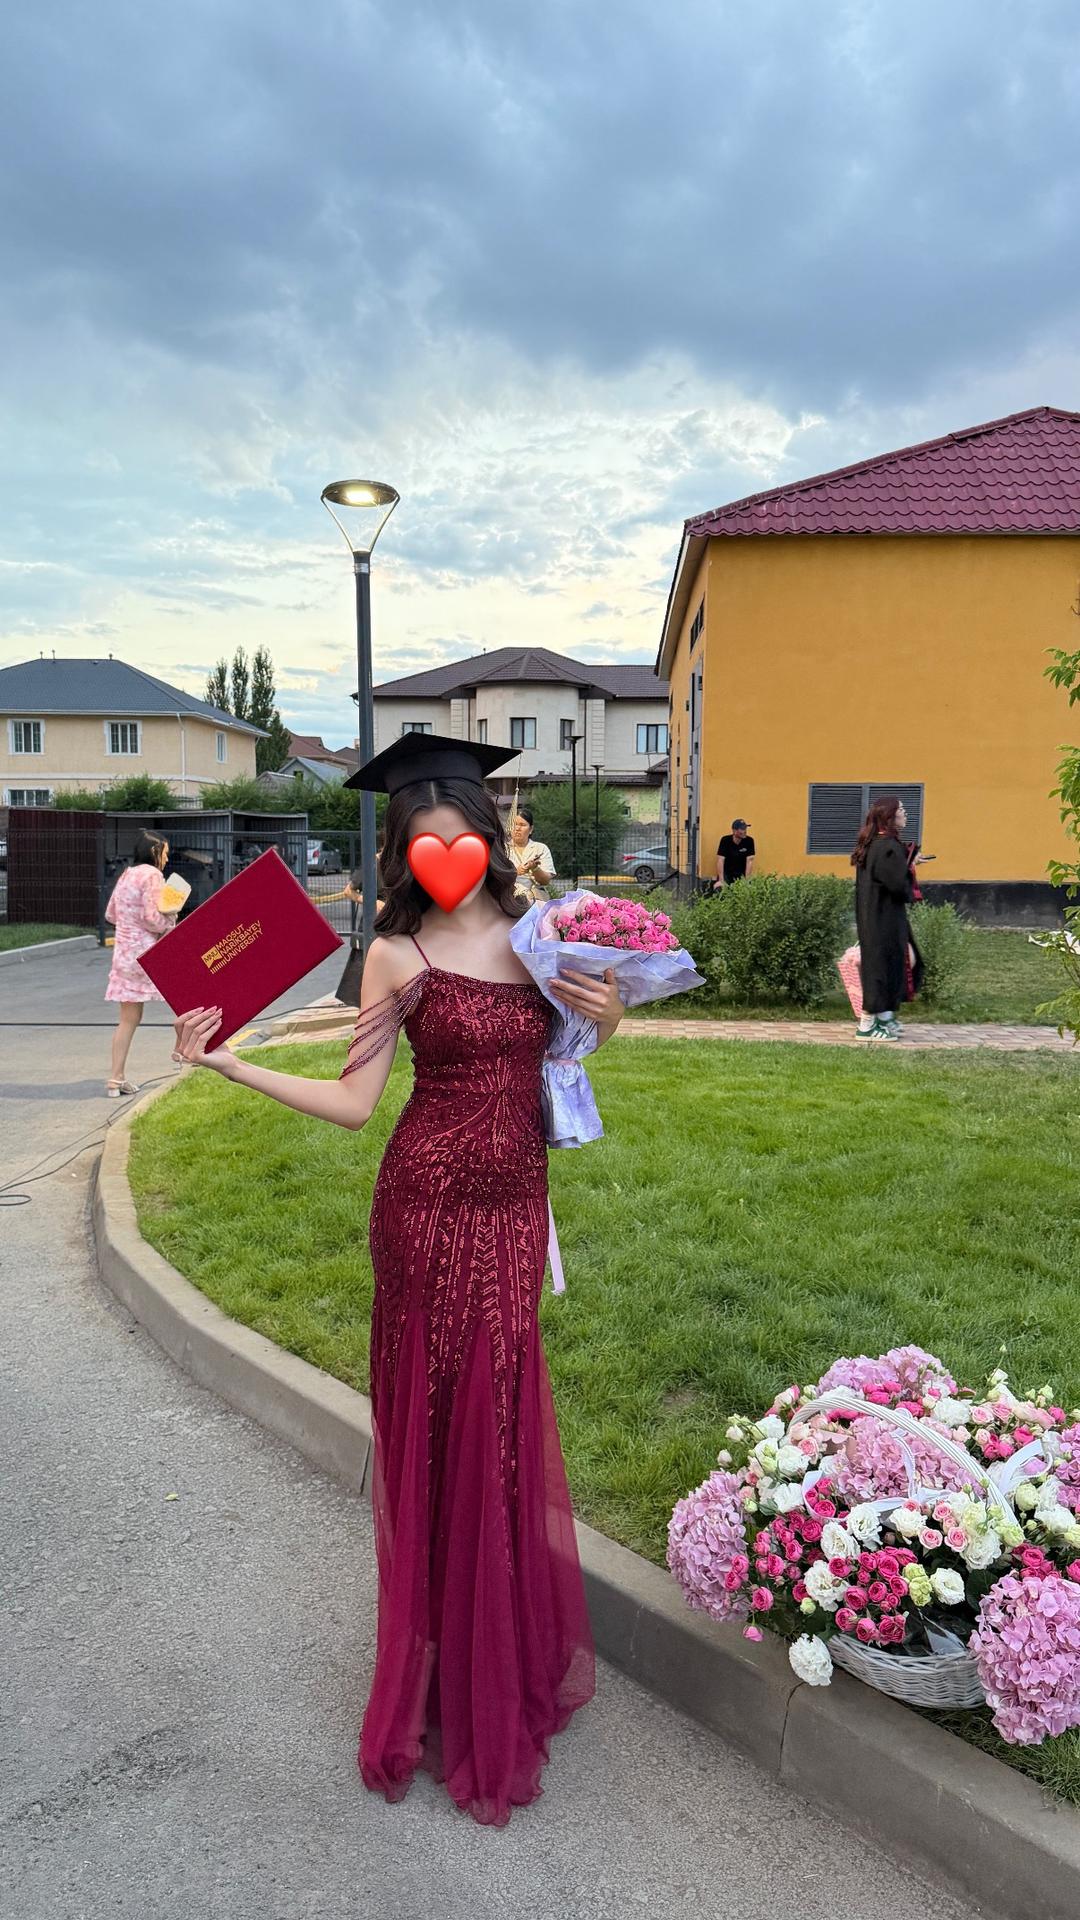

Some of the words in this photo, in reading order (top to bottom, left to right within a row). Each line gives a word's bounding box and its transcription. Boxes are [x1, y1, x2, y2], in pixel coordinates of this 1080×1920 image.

[216, 924, 245, 950] MAQSUT
[220, 920, 261, 956] NARIKBAYEV
[224, 928, 263, 962] UNIVERSITY
